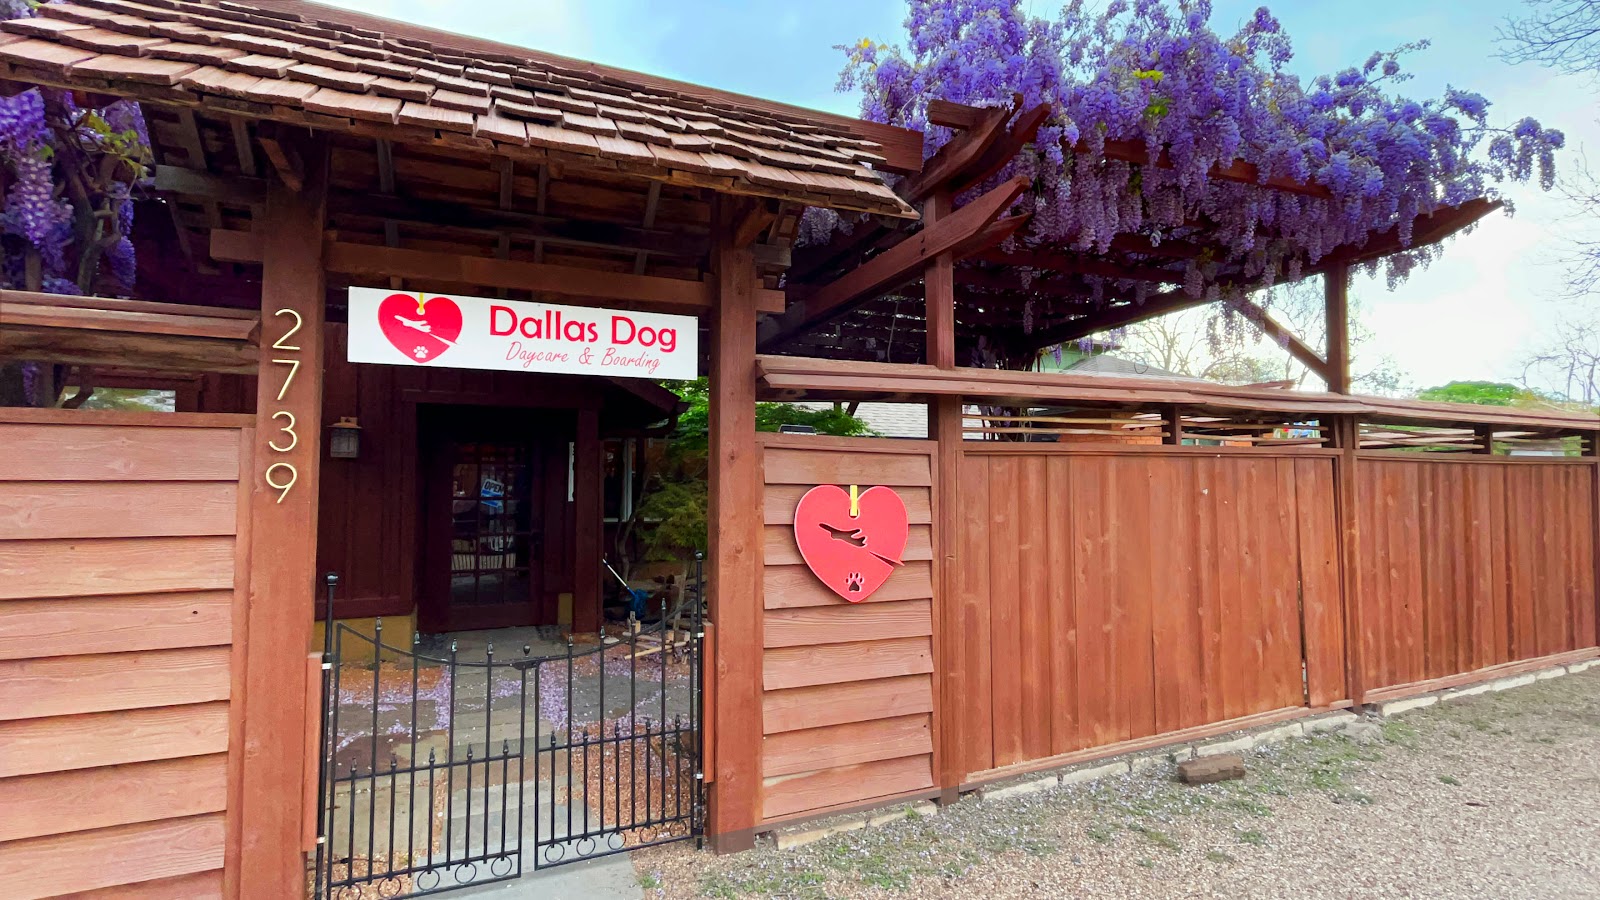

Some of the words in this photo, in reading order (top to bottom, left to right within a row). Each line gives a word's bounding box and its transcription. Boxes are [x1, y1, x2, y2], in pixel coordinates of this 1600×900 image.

[490, 305, 599, 343] Dallas
[611, 315, 677, 353] Dog
[505, 341, 569, 368] Daycare
[578, 347, 595, 366] &
[601, 347, 661, 375] Boarding
[266, 308, 302, 504] 2739
